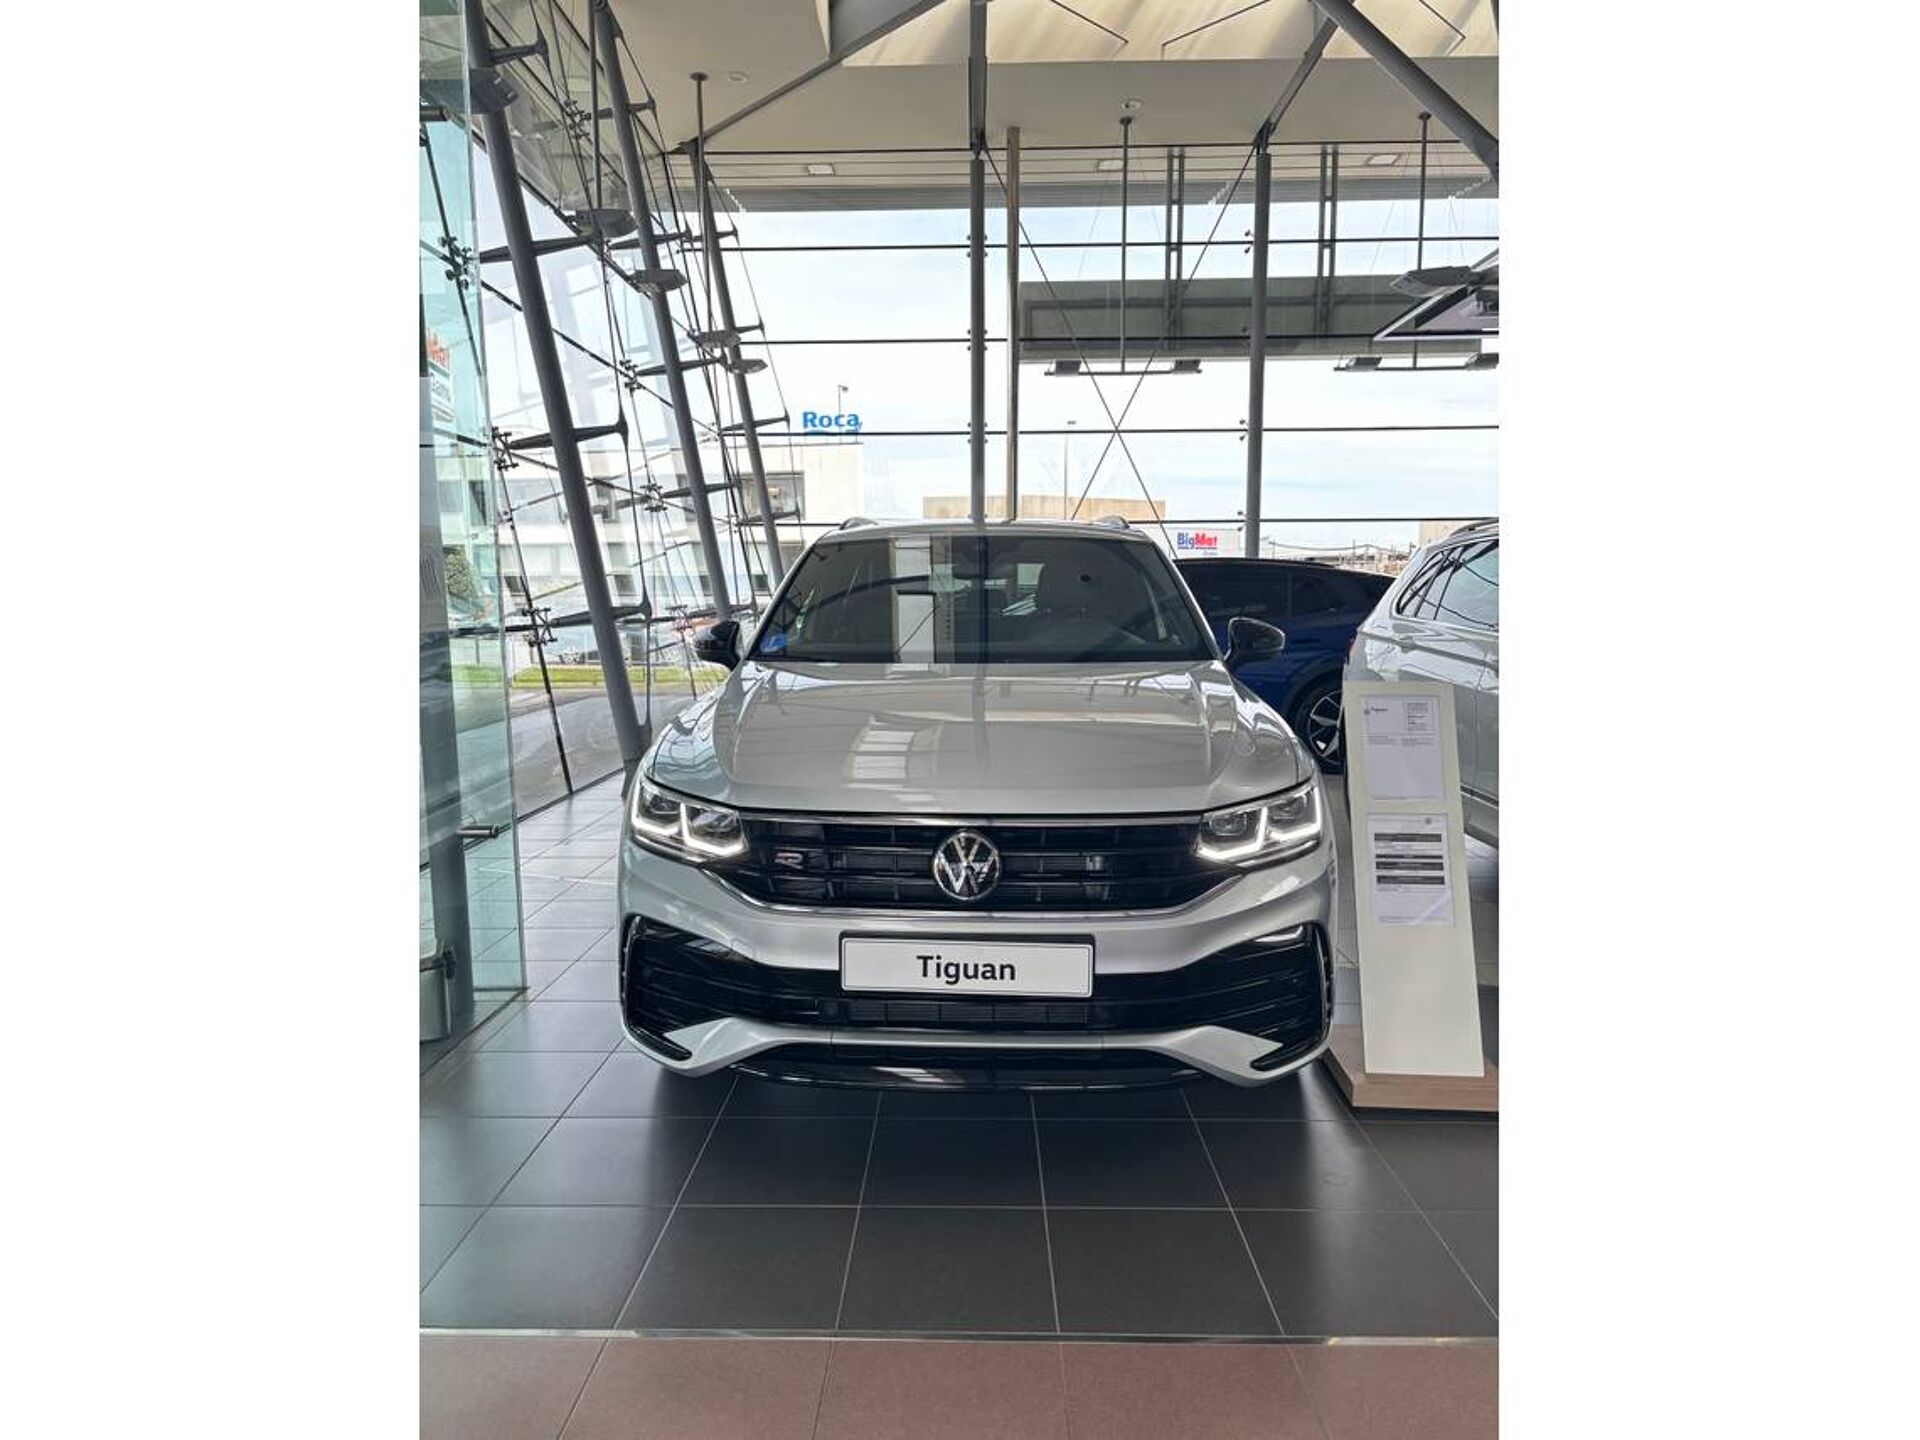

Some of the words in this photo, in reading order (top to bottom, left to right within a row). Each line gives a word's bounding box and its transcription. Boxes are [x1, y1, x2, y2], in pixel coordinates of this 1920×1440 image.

[803, 411, 859, 429] Roca
[1176, 532, 1217, 549] BigMat
[916, 954, 1016, 985] Tiguan
